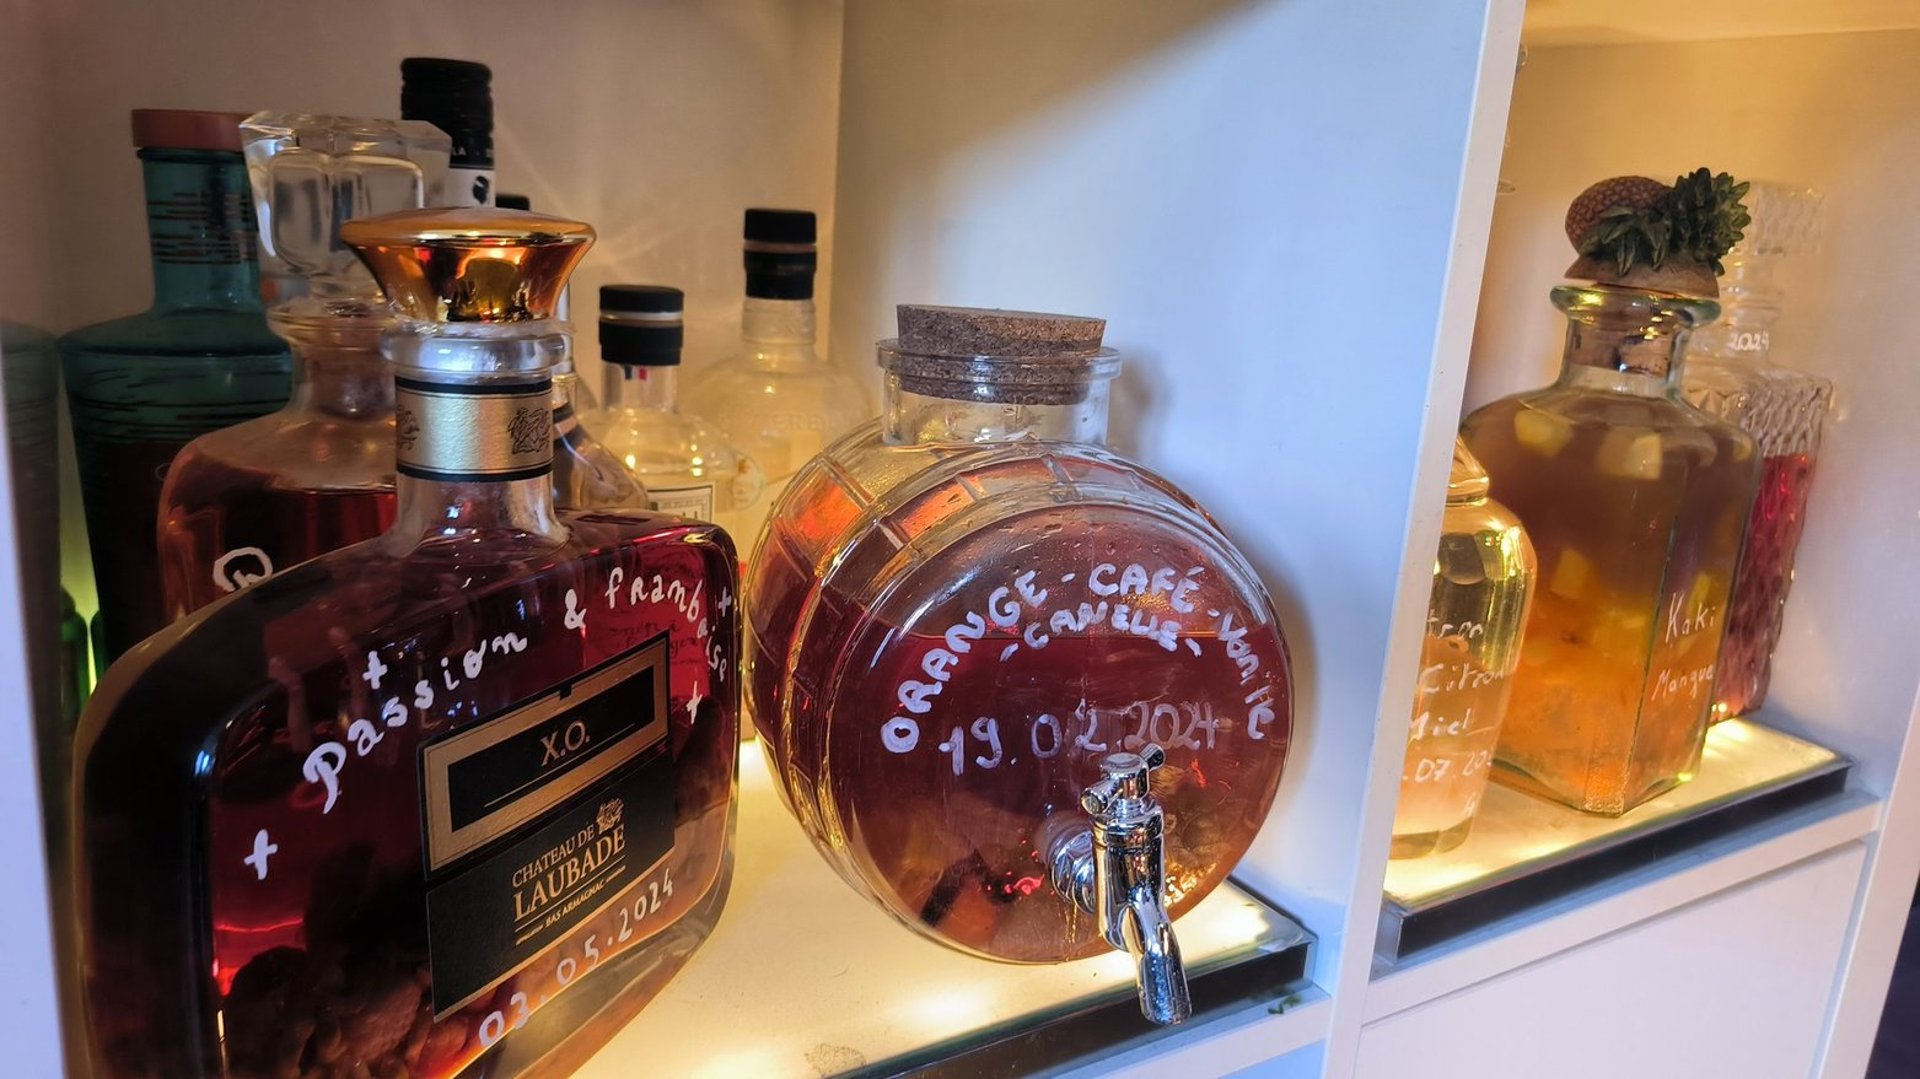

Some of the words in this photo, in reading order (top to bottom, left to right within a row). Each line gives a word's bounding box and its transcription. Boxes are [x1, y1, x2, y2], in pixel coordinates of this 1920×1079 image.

[881, 569, 1048, 753] ORANGE
[1089, 563, 1205, 613] CAFÉ
[1665, 591, 1716, 644] Kaki
[302, 631, 528, 815] Passion
[564, 589, 586, 630] &
[1651, 663, 1713, 701] Mangue
[540, 720, 591, 766] X.O.
[512, 836, 576, 888] CHATEAU
[577, 824, 595, 850] DE
[513, 823, 626, 922] LAUBADE
[478, 867, 674, 1048] 03.05.2024
